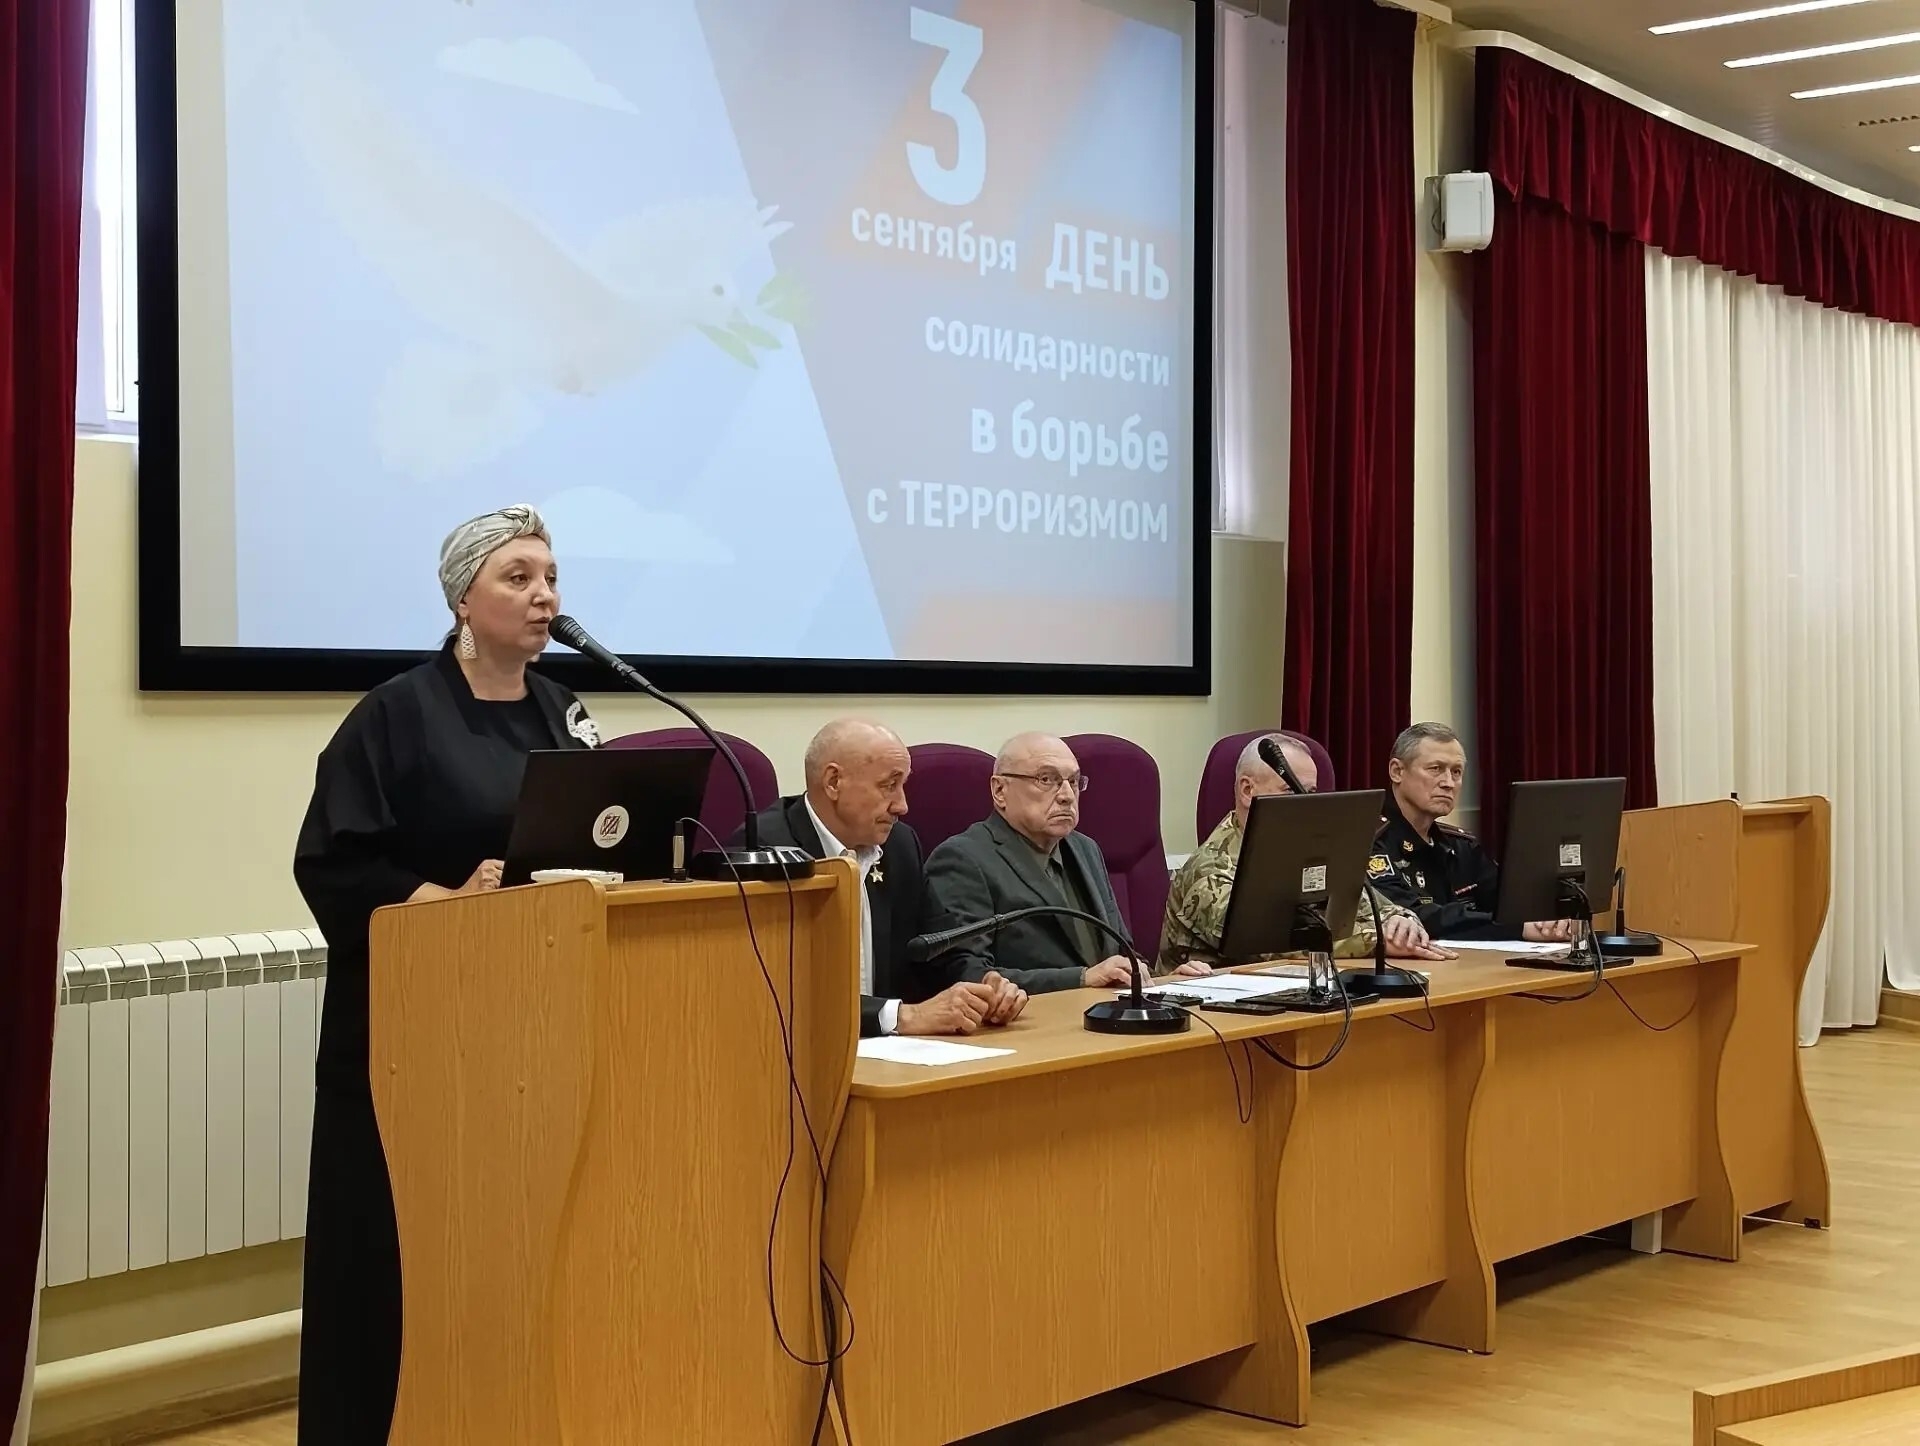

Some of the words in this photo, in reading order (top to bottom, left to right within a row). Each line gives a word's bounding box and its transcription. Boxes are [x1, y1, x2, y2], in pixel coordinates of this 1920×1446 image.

[906, 6, 986, 206] 3
[851, 207, 1016, 276] сентября
[1045, 222, 1170, 301] ДЕНЬ
[925, 316, 1170, 387] солидарности
[972, 408, 997, 454] в
[1012, 398, 1168, 476] борьбе
[867, 487, 888, 523] с
[900, 480, 1168, 543] ТЕРРОРИЗМОМ
